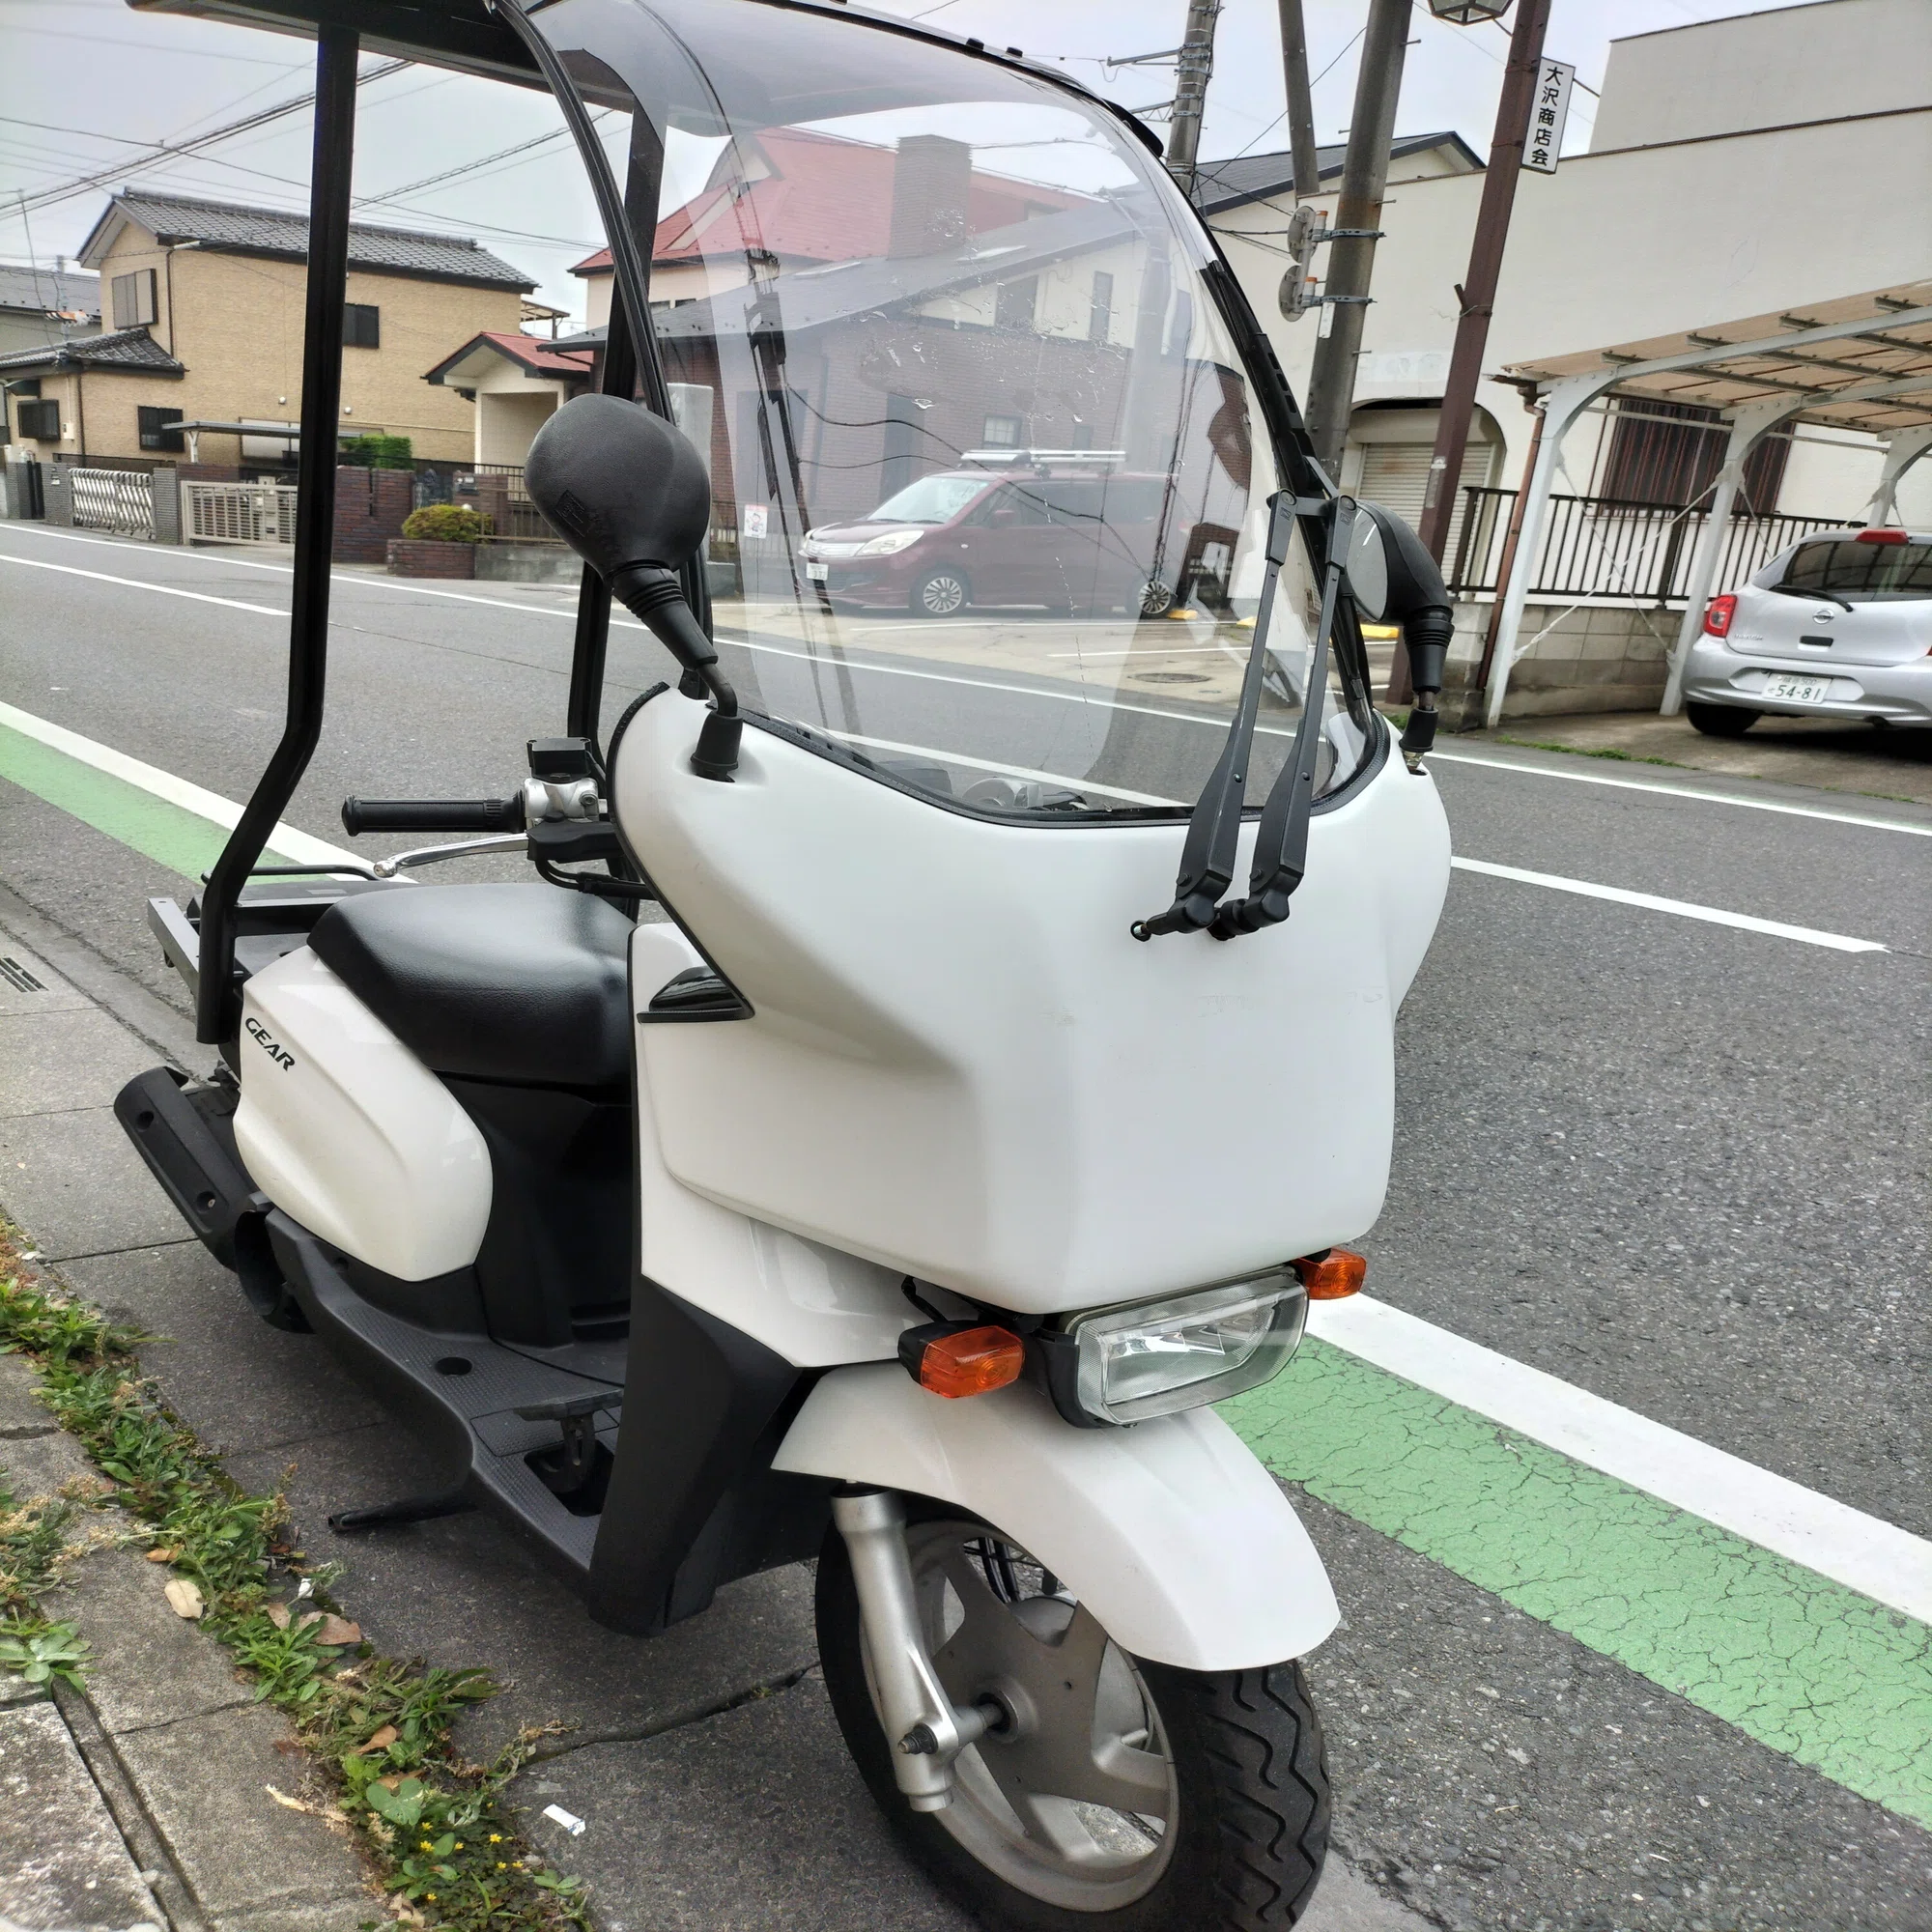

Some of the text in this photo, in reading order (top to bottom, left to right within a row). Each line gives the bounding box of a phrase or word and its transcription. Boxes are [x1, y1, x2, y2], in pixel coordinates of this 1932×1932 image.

[1530, 67, 1564, 166] 大沢商店会
[1775, 684, 1821, 700] 54-81
[245, 1017, 296, 1071] GEAR
